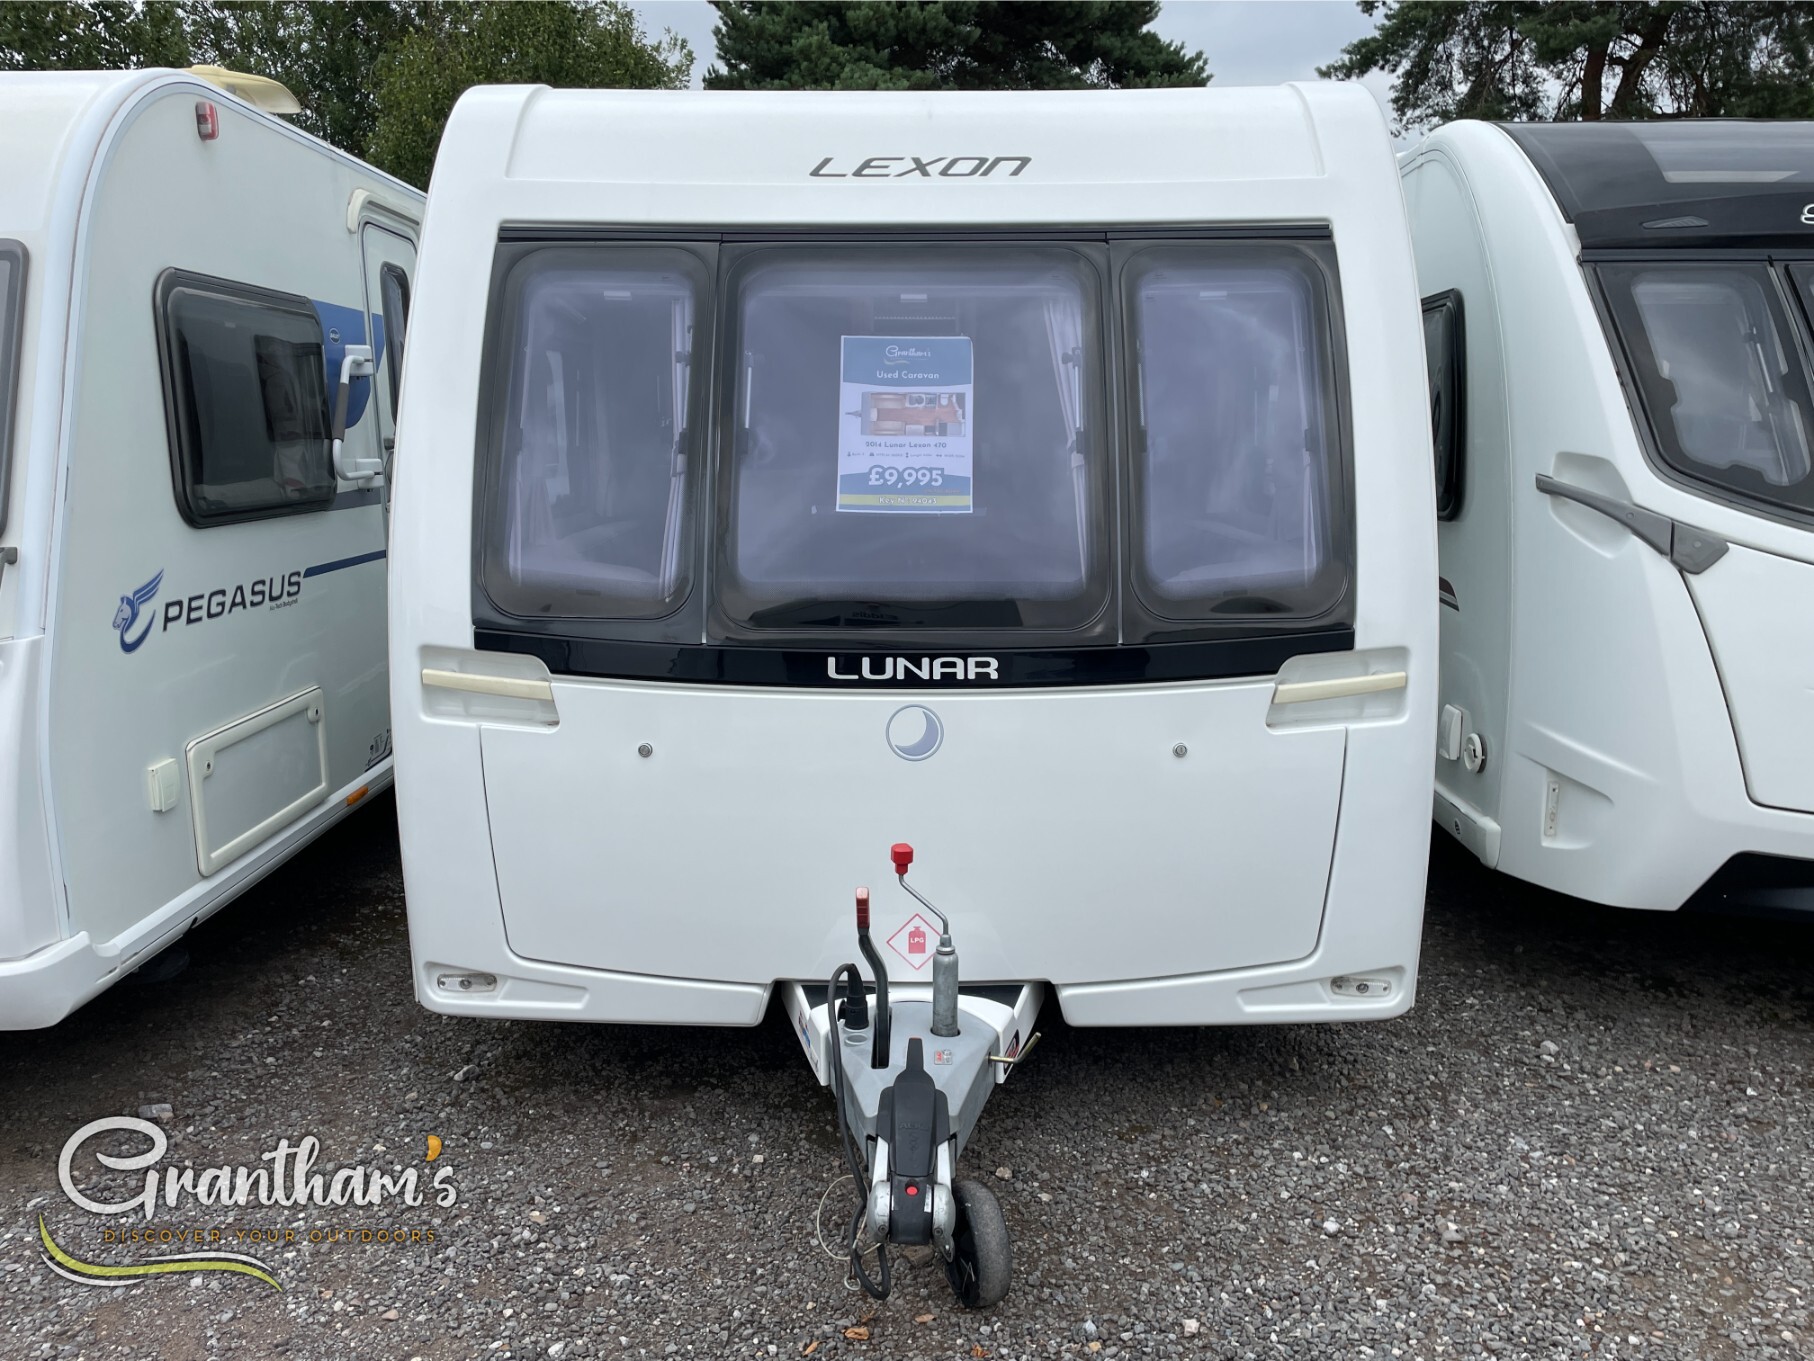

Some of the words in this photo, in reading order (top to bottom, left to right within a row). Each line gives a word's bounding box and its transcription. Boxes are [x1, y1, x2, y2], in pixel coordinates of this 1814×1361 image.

[809, 156, 1032, 177] LEXON
[876, 370, 899, 379] Used
[901, 370, 940, 379] Caravan
[868, 467, 943, 489] £9,995
[162, 570, 302, 632] PEGASUS
[827, 656, 999, 680] LUNAR
